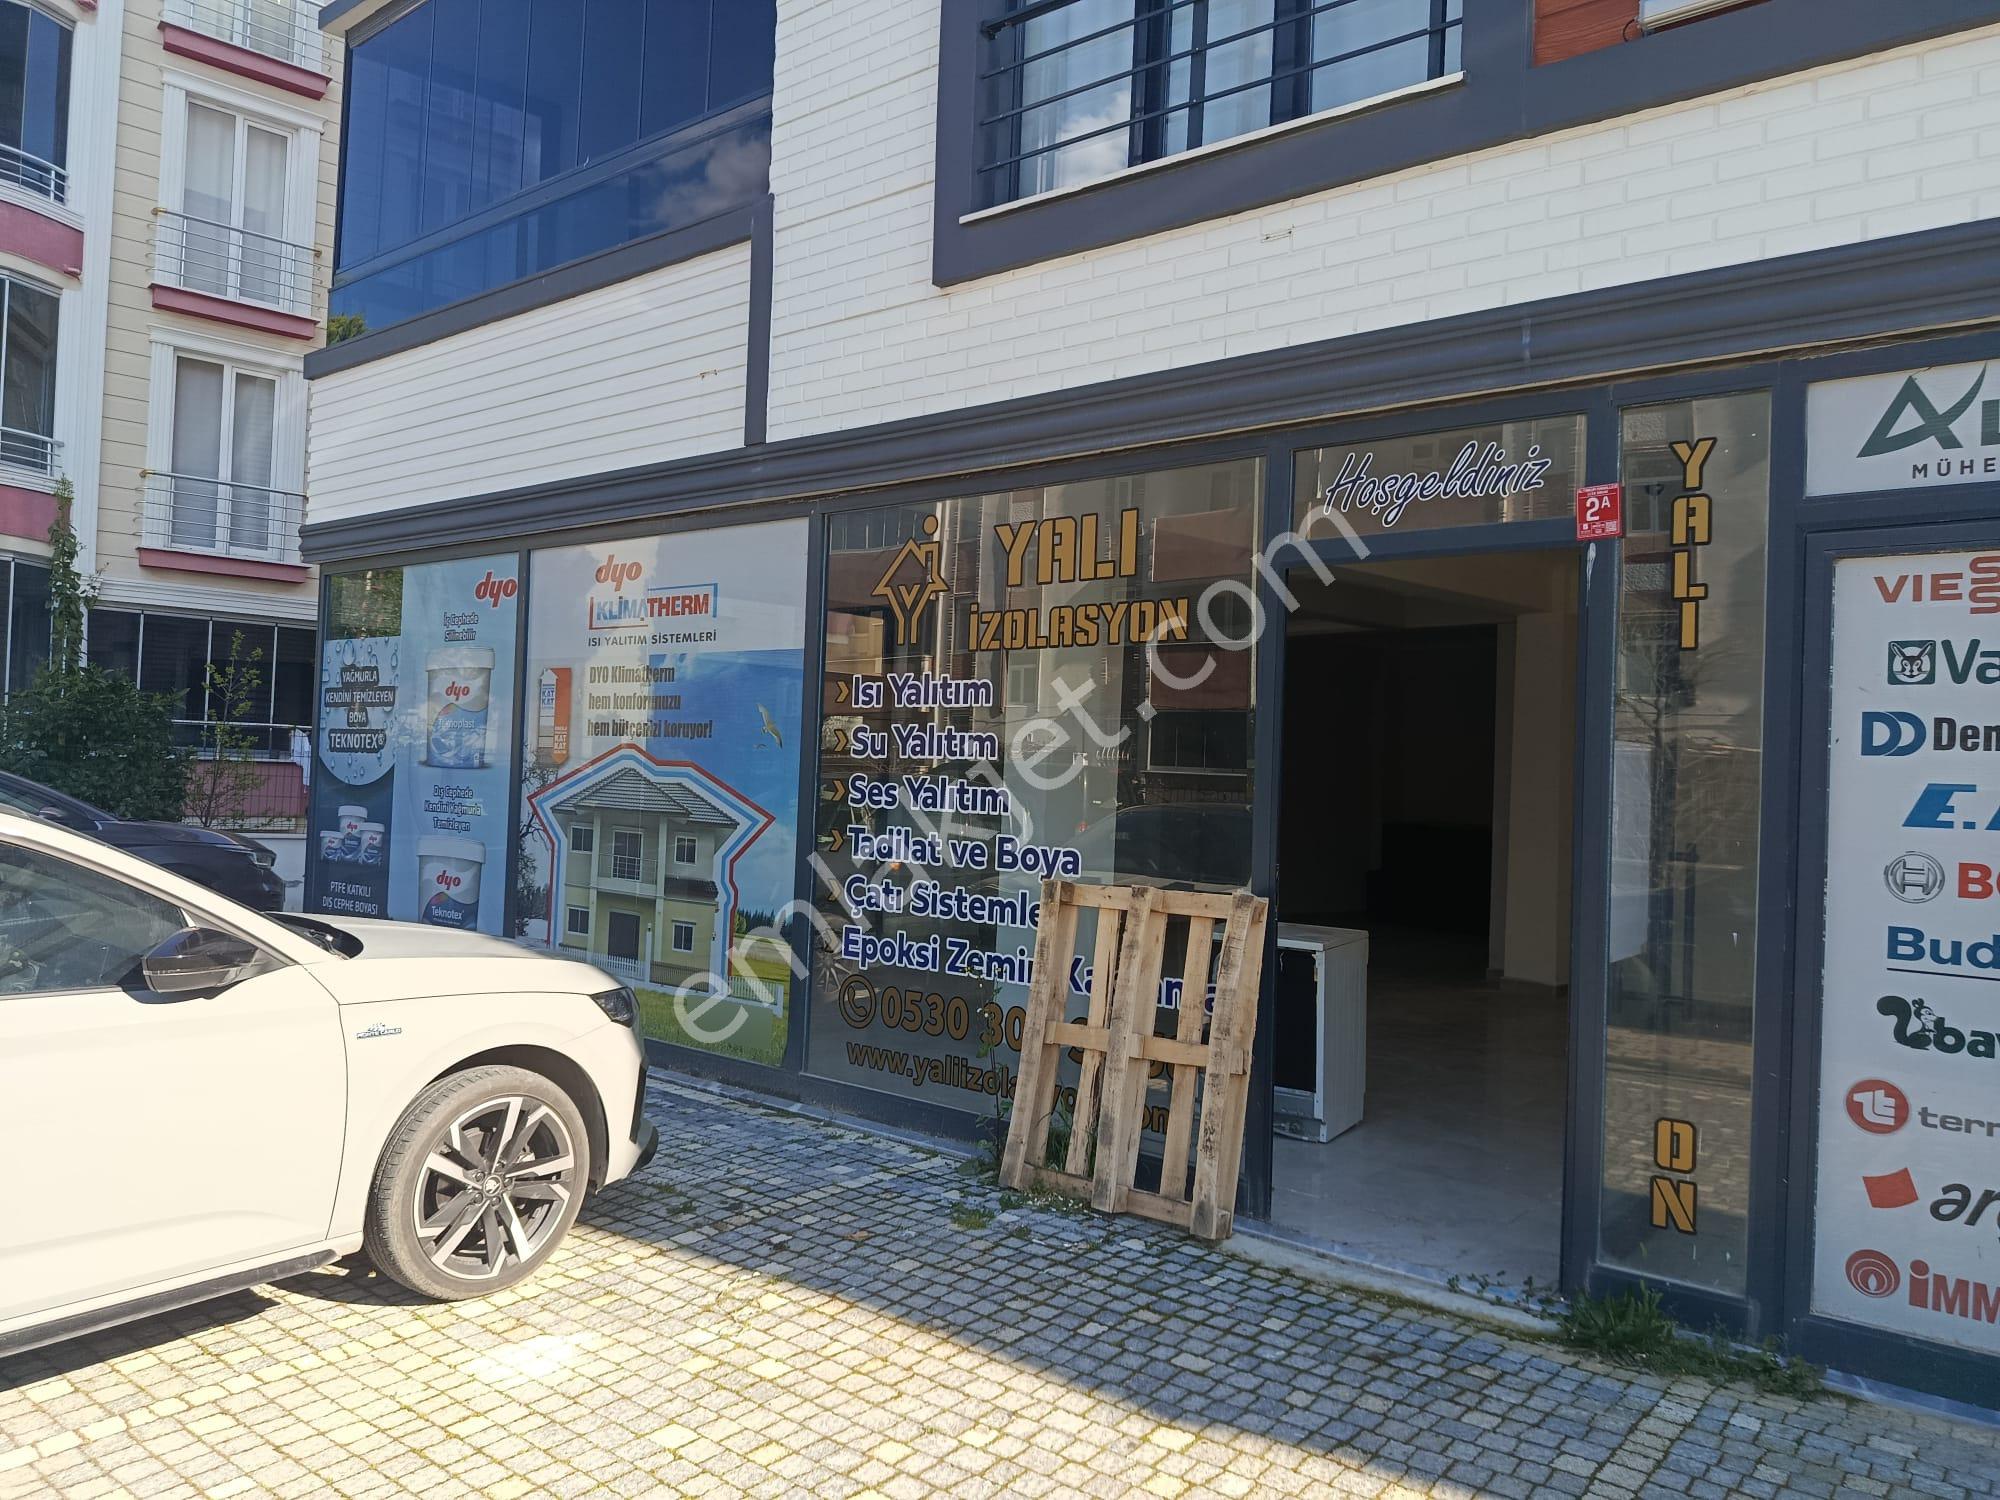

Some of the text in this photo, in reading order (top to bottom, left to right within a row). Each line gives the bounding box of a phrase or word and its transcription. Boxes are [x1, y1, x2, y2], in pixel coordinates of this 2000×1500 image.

[1324, 441, 1551, 527] Hoşgeldiniz
[1912, 457, 1997, 479] MÜHE
[995, 508, 1139, 587] YALI
[1669, 437, 1717, 649] YALI
[474, 569, 518, 608] dyo
[594, 554, 642, 592] dyo
[596, 593, 710, 622] KLİMATHERM
[588, 629, 717, 647] ISI YALITIM SİSTEMLERİ
[968, 597, 1189, 651] İZOLASYON
[342, 669, 378, 682] YAĞMURLA
[589, 664, 675, 685] DYO Klimatherm
[325, 688, 394, 703] KENDİNİ TEMİZLEYEN
[445, 681, 470, 701] dyo
[588, 692, 681, 710] hem konforunuzu
[852, 673, 993, 709] Isı Yalıtım
[349, 711, 367, 723] BOYA
[587, 719, 609, 737] hem
[664, 719, 713, 739] koruyor!
[850, 724, 998, 760] Su Yalıtım
[848, 773, 1011, 816] Ses Yalıtım
[847, 825, 1081, 883] Tadilat ve Boya
[330, 881, 371, 897] PTFE KATKILI
[436, 869, 461, 891] dyo
[323, 896, 378, 915] DIŞ CEPHE BOYASI
[844, 874, 1041, 930] Çatı Sistemle
[842, 925, 940, 970] Epoksi
[880, 986, 969, 1041] 0530
[979, 1002, 1028, 1052] 30
